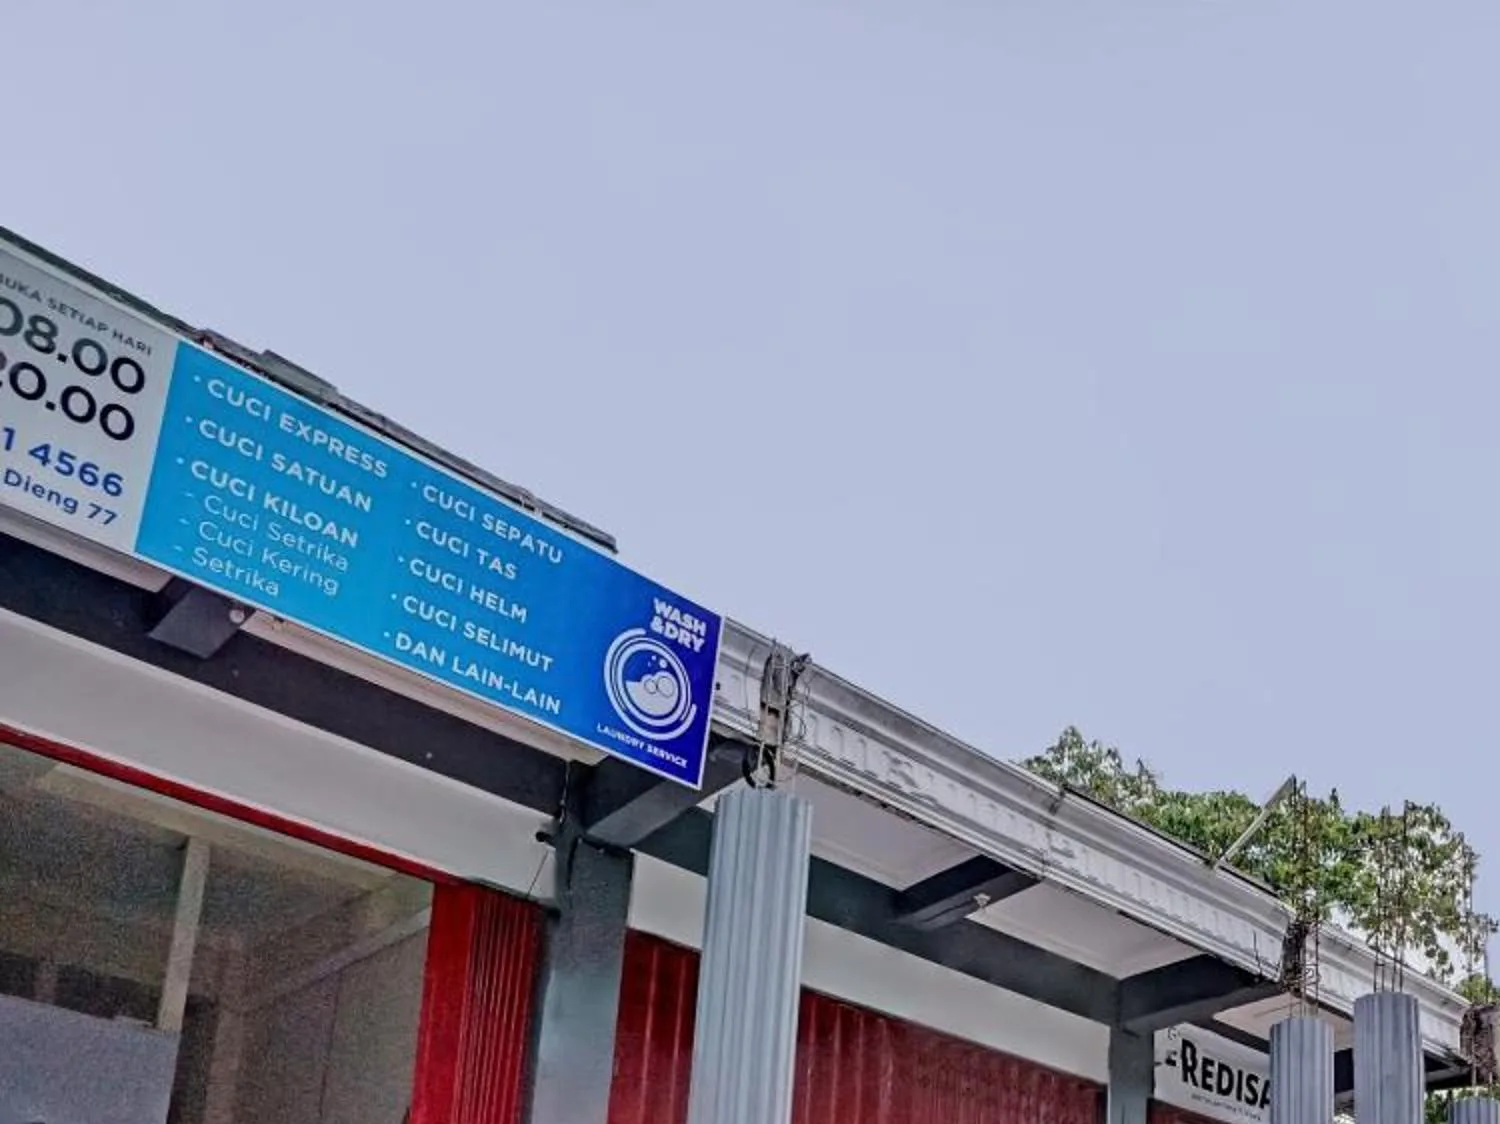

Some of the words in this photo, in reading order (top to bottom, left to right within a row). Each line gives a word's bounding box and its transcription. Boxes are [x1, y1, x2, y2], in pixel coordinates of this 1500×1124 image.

[0, 296, 145, 394] 08.00
[47, 298, 108, 332] SETIAP
[112, 329, 152, 356] HARI
[0, 352, 135, 441] 0.00
[206, 378, 270, 421] CUCI
[279, 413, 388, 478] EXPRESS
[4, 468, 79, 514] Dieng
[87, 502, 118, 525] 77
[28, 443, 124, 497] 4566
[199, 419, 262, 460] CUCI
[271, 453, 373, 512] SATUAN
[190, 460, 256, 502] CUCI
[263, 492, 359, 548] KILOAN
[204, 495, 258, 530] Cuci
[268, 523, 349, 571] Setrika
[422, 485, 475, 521] CUCI
[483, 513, 563, 564] SEPATU
[192, 546, 279, 597] Setrika
[199, 521, 253, 556] Cuci
[261, 550, 339, 596] Kering
[416, 521, 469, 557] CUCI
[477, 548, 517, 580] TAS
[409, 558, 463, 594] CUCI
[470, 581, 527, 623] HELM
[653, 597, 707, 637] WASH
[403, 596, 457, 630] CUCI
[463, 618, 554, 672] SELIMUT
[651, 615, 705, 653] &DRY
[396, 632, 445, 666] DAN
[452, 653, 561, 715] LAIN-LAIN
[597, 722, 645, 750] LAUNDRY
[647, 743, 688, 769] SERVICE
